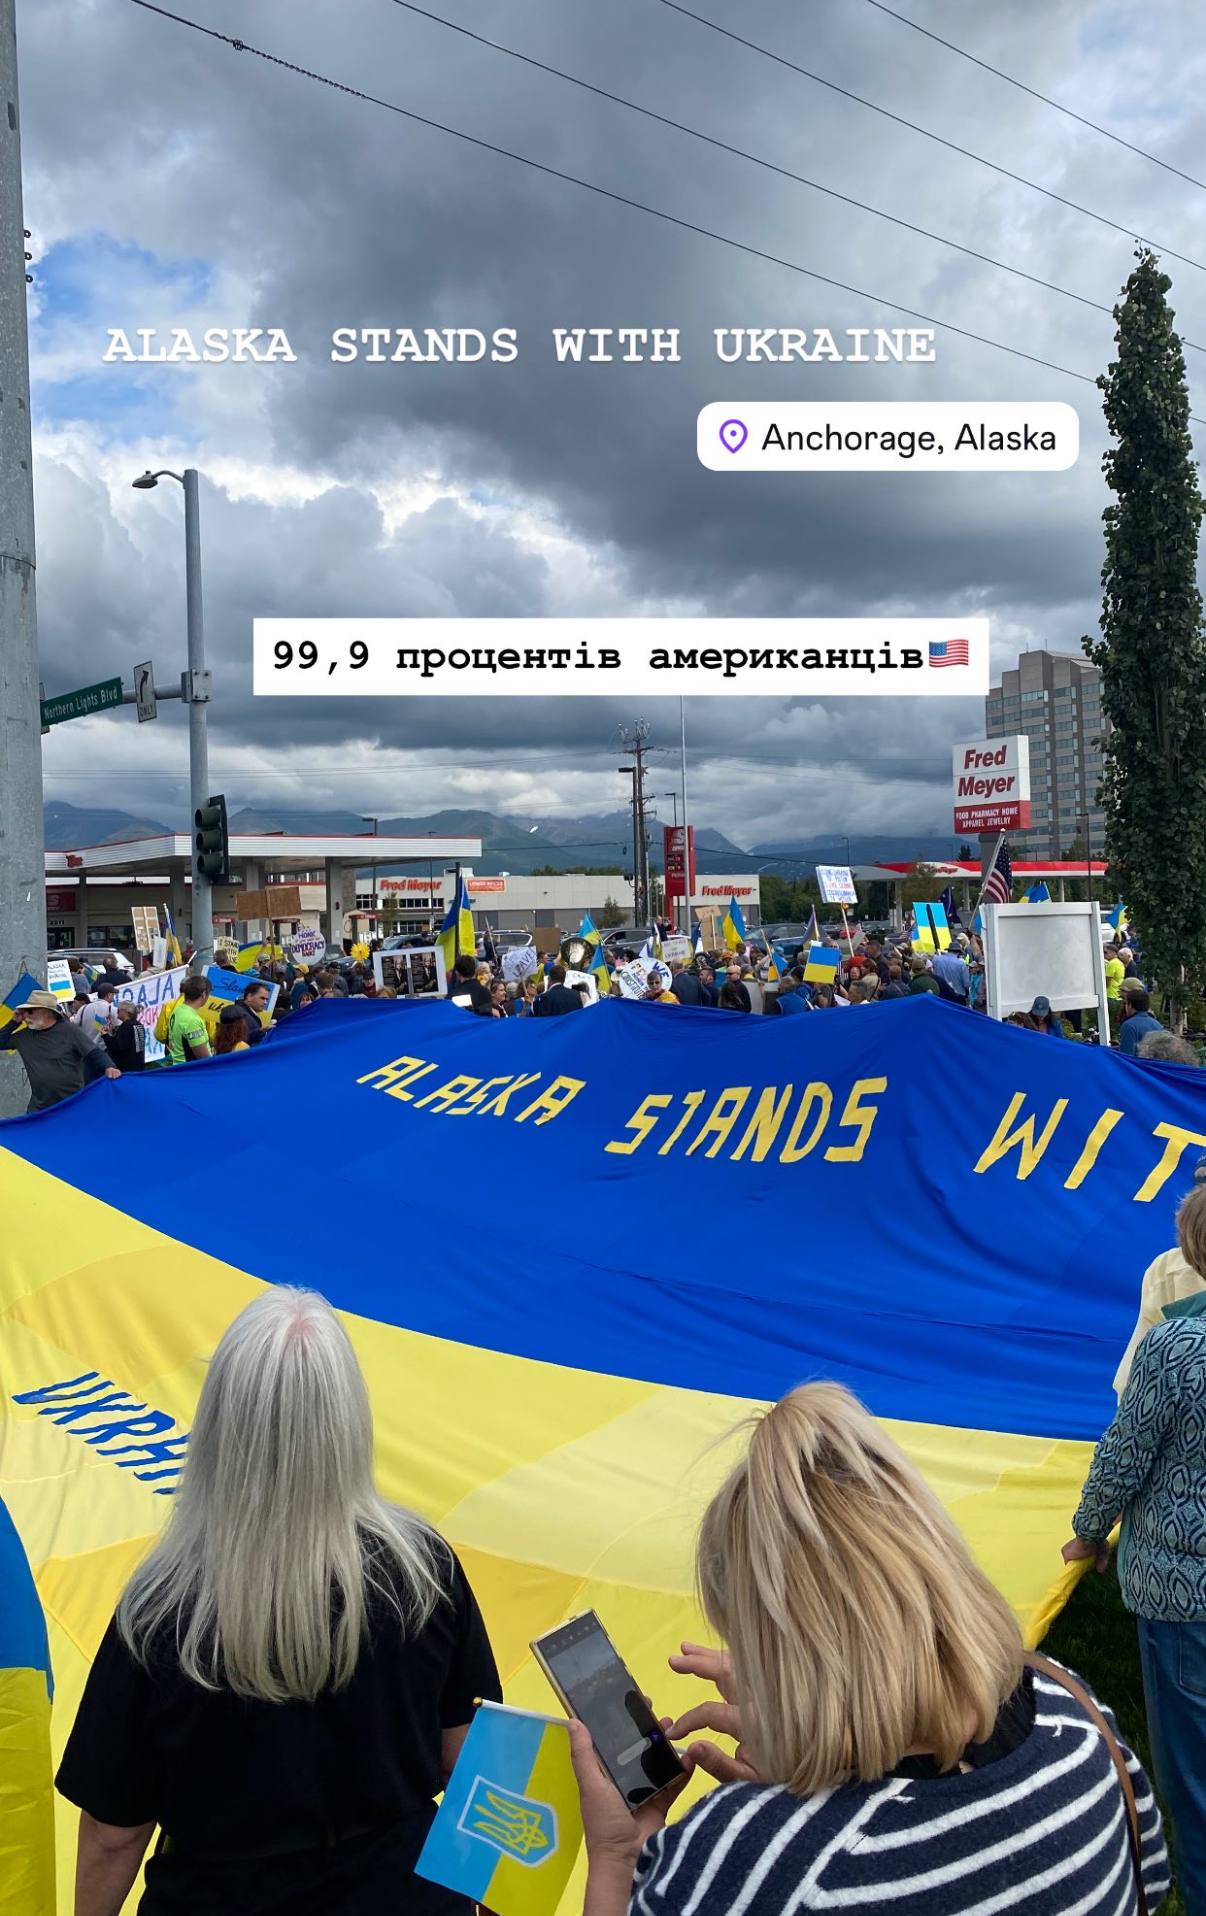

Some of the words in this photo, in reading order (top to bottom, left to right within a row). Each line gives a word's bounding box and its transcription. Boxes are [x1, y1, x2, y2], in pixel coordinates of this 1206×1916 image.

[44, 701, 74, 719] Northern
[76, 693, 98, 712] Lights
[100, 686, 118, 704] Blvd
[139, 703, 154, 717] ONLY
[963, 744, 1008, 770] Fred
[957, 776, 1016, 799] Meyer
[955, 811, 969, 819] FOOD
[971, 808, 1000, 819] PHARMACY
[1001, 806, 1019, 815] HOME
[962, 819, 985, 828] APPAREL
[986, 816, 1011, 826] JEWELRY
[380, 880, 406, 891] Fred
[407, 880, 442, 892] Meyer
[702, 885, 724, 896] Fred
[723, 885, 752, 898] Meyer
[291, 940, 325, 953] DEMOCRACY
[652, 961, 670, 978] WE
[355, 1056, 587, 1126] ALASKA
[604, 1076, 889, 1164] STANDS
[973, 1091, 1206, 1202] WIT
